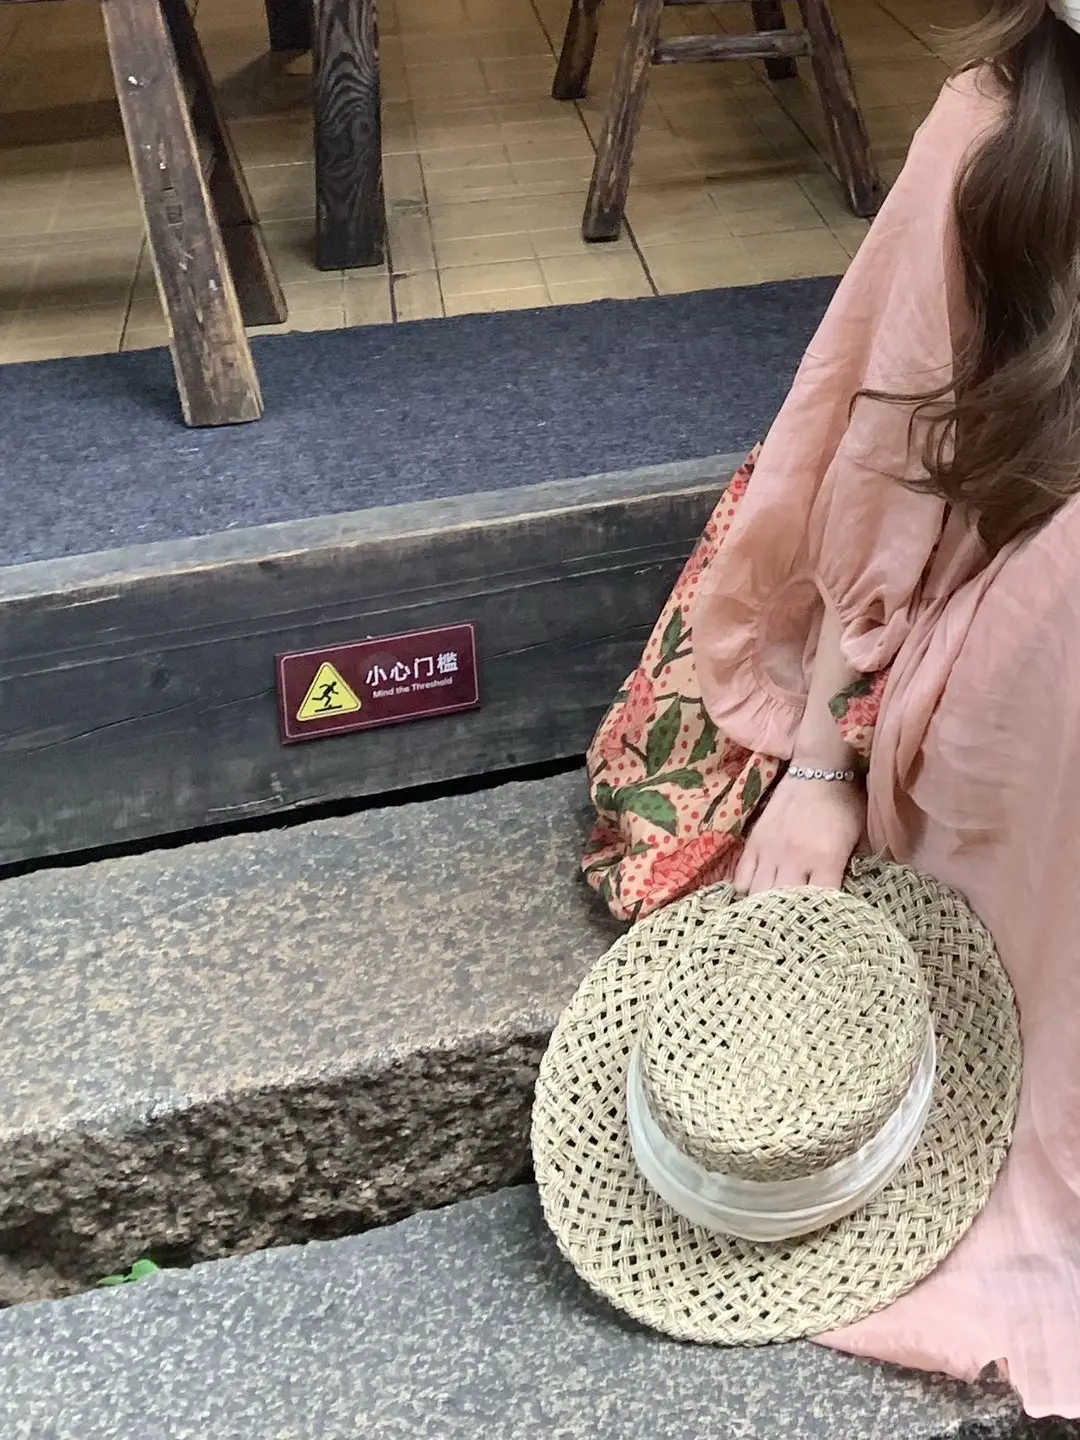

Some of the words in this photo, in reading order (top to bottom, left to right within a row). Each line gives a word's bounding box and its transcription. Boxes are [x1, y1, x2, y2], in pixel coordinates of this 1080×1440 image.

[365, 651, 459, 686] 小心门槛
[372, 687, 394, 698] Mind
[395, 685, 410, 695] the
[411, 676, 453, 691] Threshold
